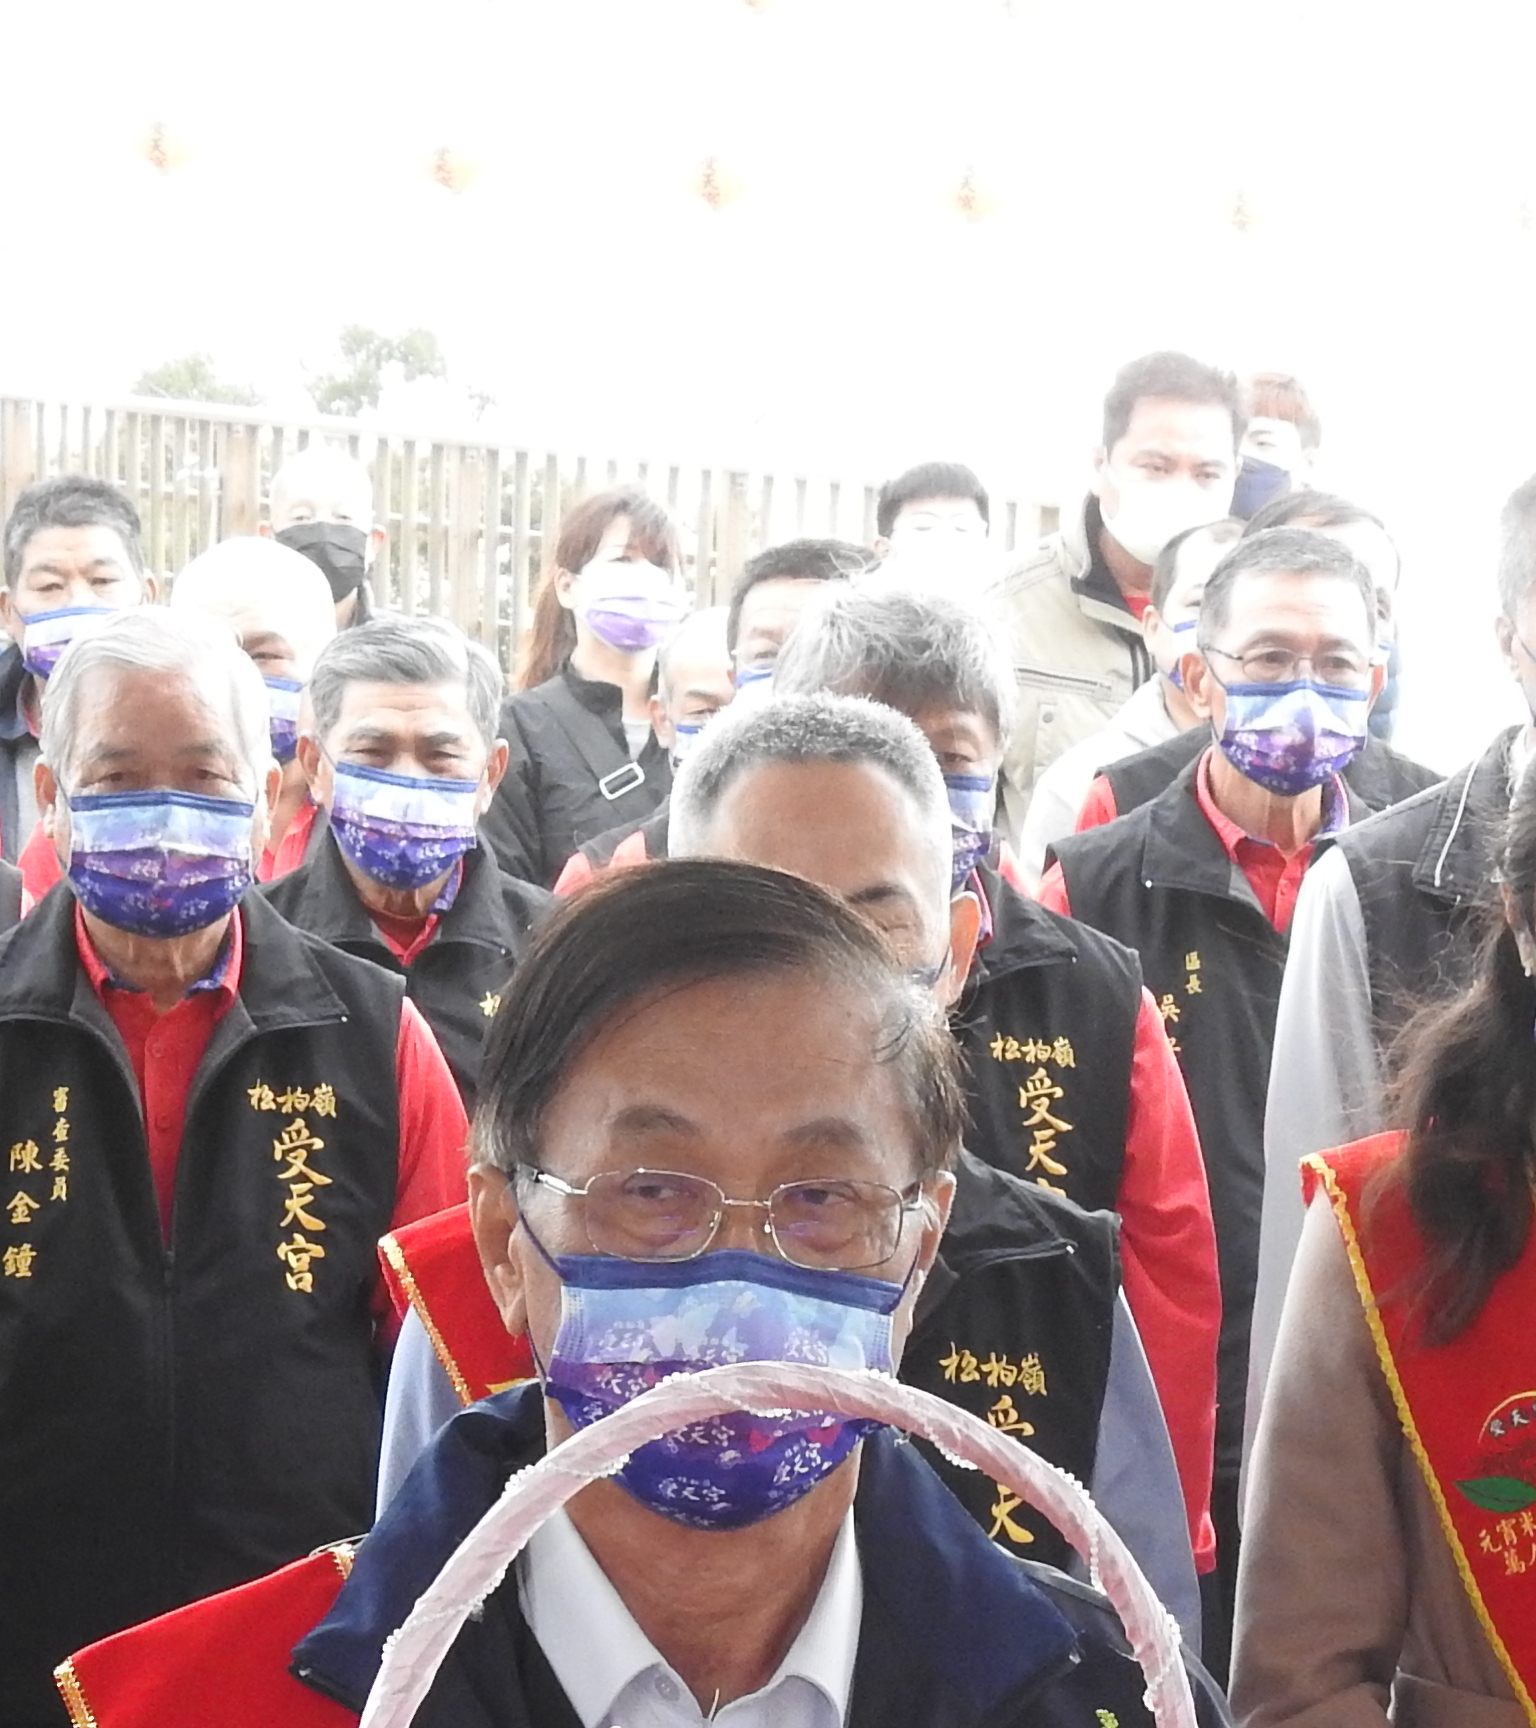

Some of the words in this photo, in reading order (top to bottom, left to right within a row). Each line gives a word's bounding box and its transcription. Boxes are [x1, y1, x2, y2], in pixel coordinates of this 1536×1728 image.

[989, 1032, 1076, 1069] 松柏嶺
[247, 1078, 338, 1119] 松柏嶺
[272, 1117, 333, 1294] 受天宮
[939, 1341, 1048, 1397] 松柏嶺
